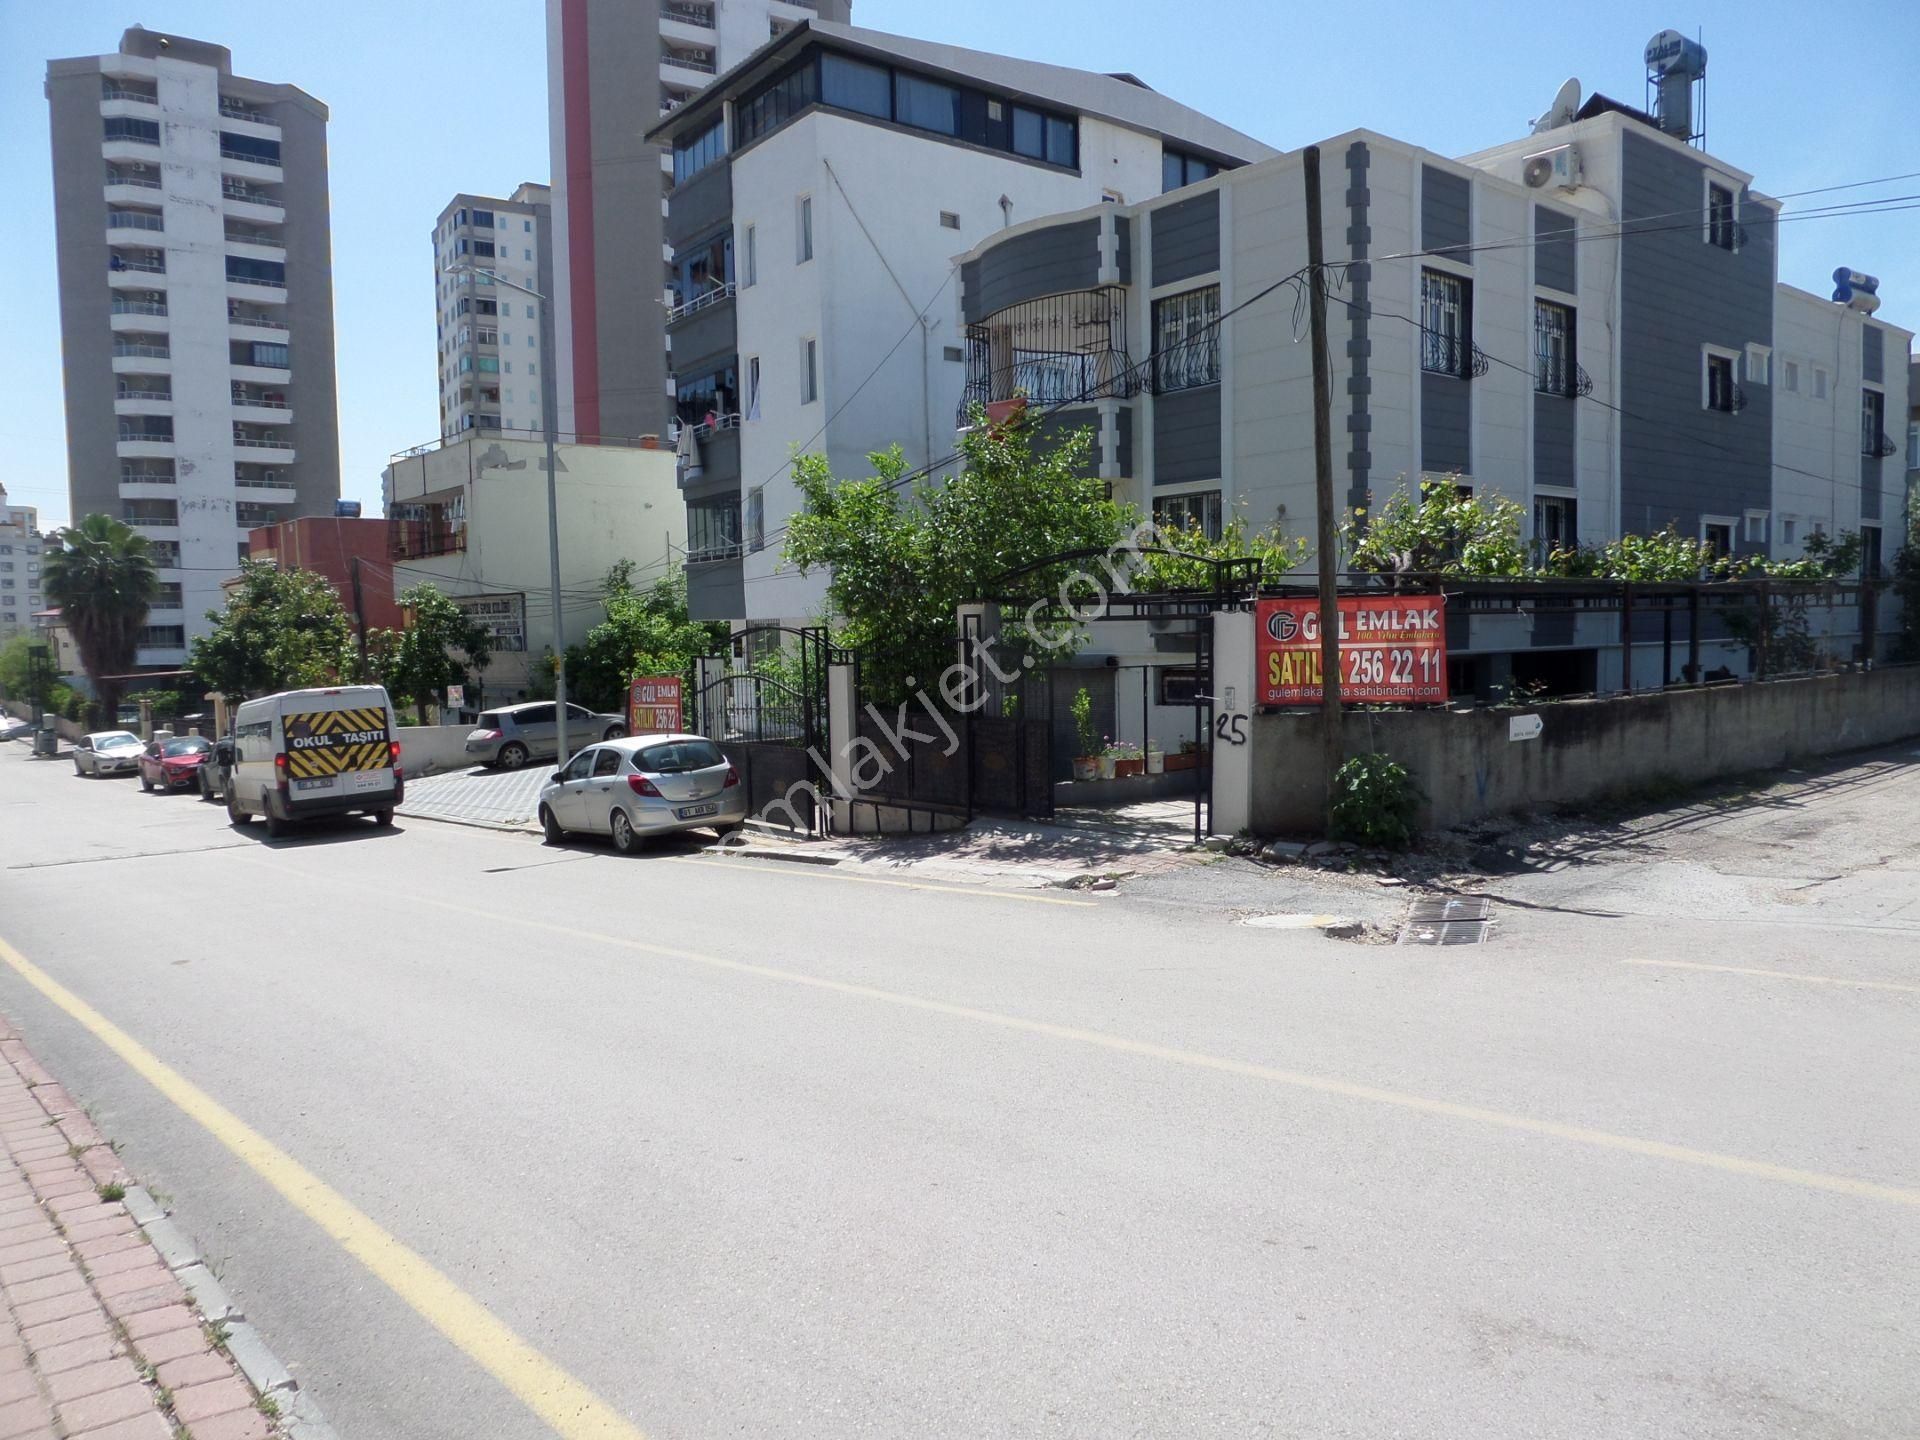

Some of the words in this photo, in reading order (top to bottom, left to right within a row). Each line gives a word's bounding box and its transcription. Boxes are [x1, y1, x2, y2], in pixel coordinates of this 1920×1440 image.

[1302, 611, 1350, 641] GL
[1356, 609, 1439, 630] EMLAK
[1268, 650, 1344, 686] SATIL
[1349, 649, 1384, 684] 256
[1389, 649, 1414, 684] 22
[1420, 648, 1440, 683] 11
[1268, 685, 1441, 700] gulemlakana.sahibinden.com
[294, 736, 333, 748] OKUL
[342, 731, 384, 744] TAŞITI
[1216, 712, 1248, 746] 25
